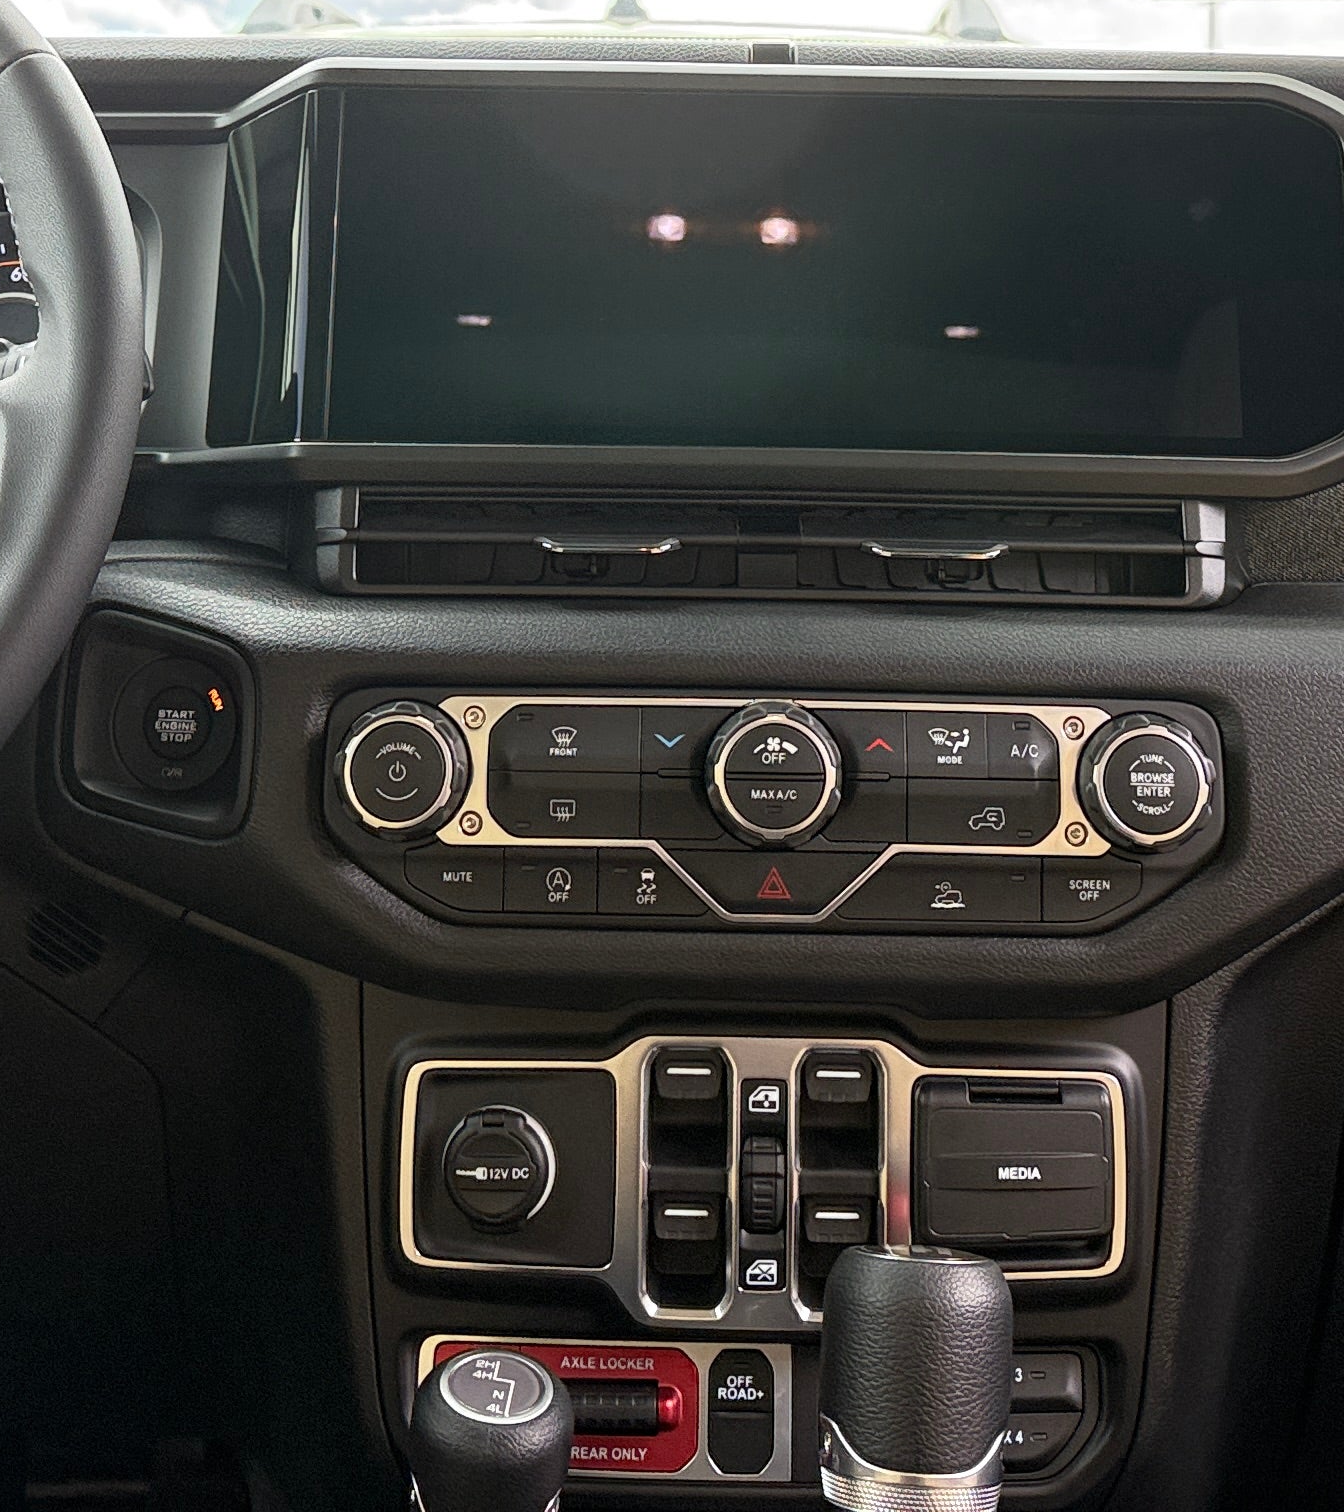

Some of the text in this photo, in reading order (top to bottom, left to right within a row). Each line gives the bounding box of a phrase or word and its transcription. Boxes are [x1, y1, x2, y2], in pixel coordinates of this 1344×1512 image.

[208, 688, 224, 712] RUN
[157, 709, 196, 720] START
[155, 721, 197, 732] ENGINE
[160, 732, 192, 743] STOP
[379, 742, 417, 756] VOLUME
[549, 747, 578, 757] FRONT
[1011, 743, 1039, 759] A/C
[761, 752, 787, 765] OFF
[937, 755, 963, 766] MODE
[1140, 754, 1164, 766] TUNE
[1130, 772, 1175, 784] BROWSE
[750, 788, 798, 802] MAX A/C
[1136, 786, 1171, 798] ENTER
[1136, 802, 1171, 816] SCROLL
[442, 871, 473, 884] MUTE
[1069, 879, 1111, 891] SCREEN
[547, 892, 570, 904] OFF
[636, 894, 657, 906] OFF
[1079, 890, 1100, 902] OFF
[489, 1167, 530, 1180] 12V DC
[997, 1166, 1041, 1181] MEDIA
[476, 1359, 495, 1370] 2H
[560, 1355, 655, 1370] AXLE LOCKER
[473, 1370, 494, 1380] 4H
[1014, 1367, 1023, 1382] 3
[726, 1375, 754, 1387] OFF
[492, 1389, 504, 1400] N
[717, 1387, 765, 1401] ROAD+
[485, 1403, 504, 1415] 4L
[1014, 1430, 1023, 1444] 4
[570, 1445, 648, 1461] REAR ONLY
